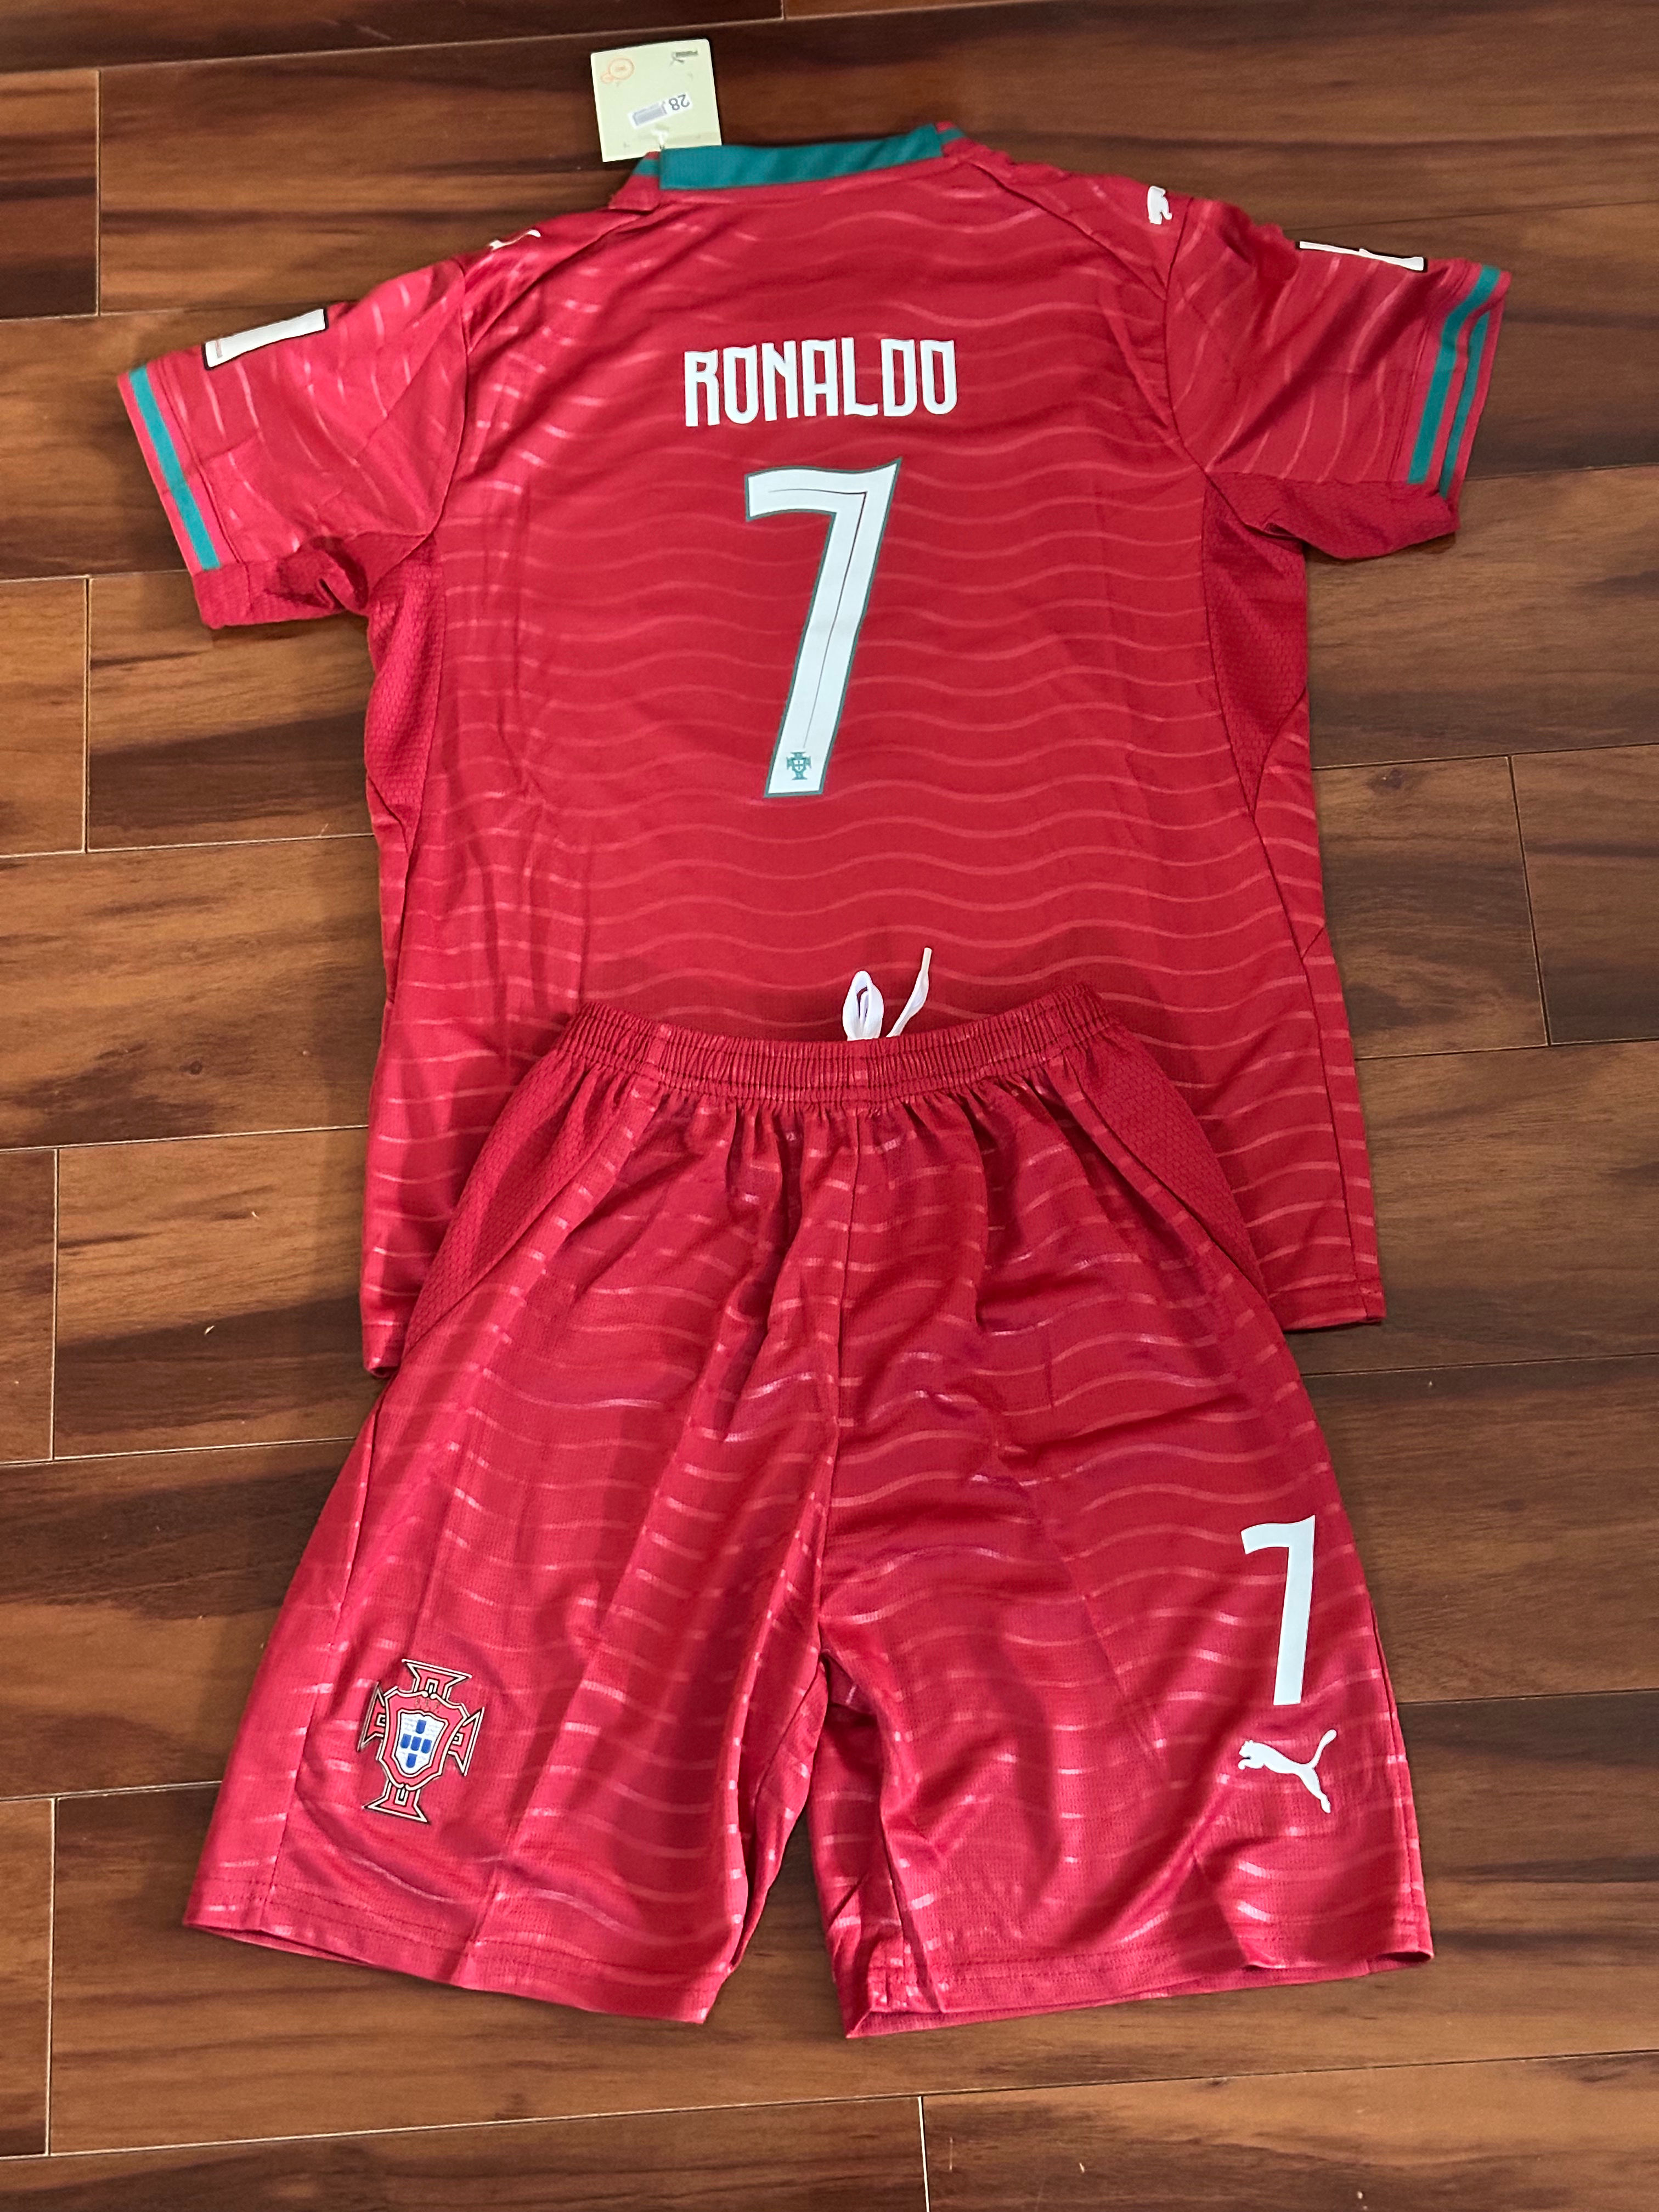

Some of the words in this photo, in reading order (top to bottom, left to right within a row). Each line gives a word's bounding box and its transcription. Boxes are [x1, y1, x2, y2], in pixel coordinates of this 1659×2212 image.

[668, 93, 691, 111] 28
[684, 337, 957, 427] RONALDO
[744, 458, 901, 798] 7
[1240, 1515, 1316, 1706] 7
